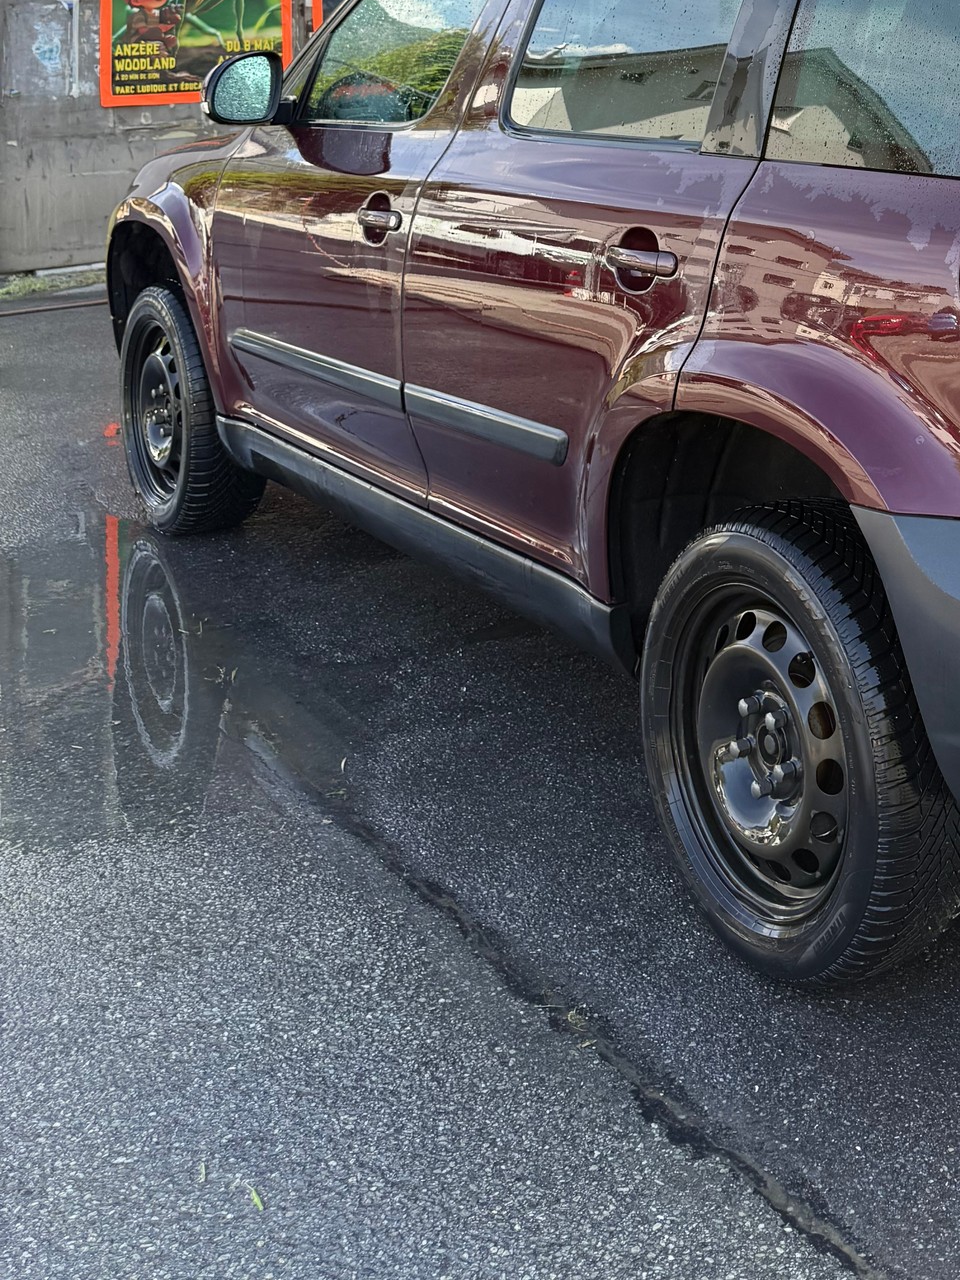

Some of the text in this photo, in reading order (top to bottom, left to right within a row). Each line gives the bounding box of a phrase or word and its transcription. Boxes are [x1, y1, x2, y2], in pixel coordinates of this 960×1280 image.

[114, 40, 161, 57] ANZÈRE
[226, 40, 241, 53] DU
[114, 56, 177, 72] WOODLAND
[115, 86, 135, 94] PARC
